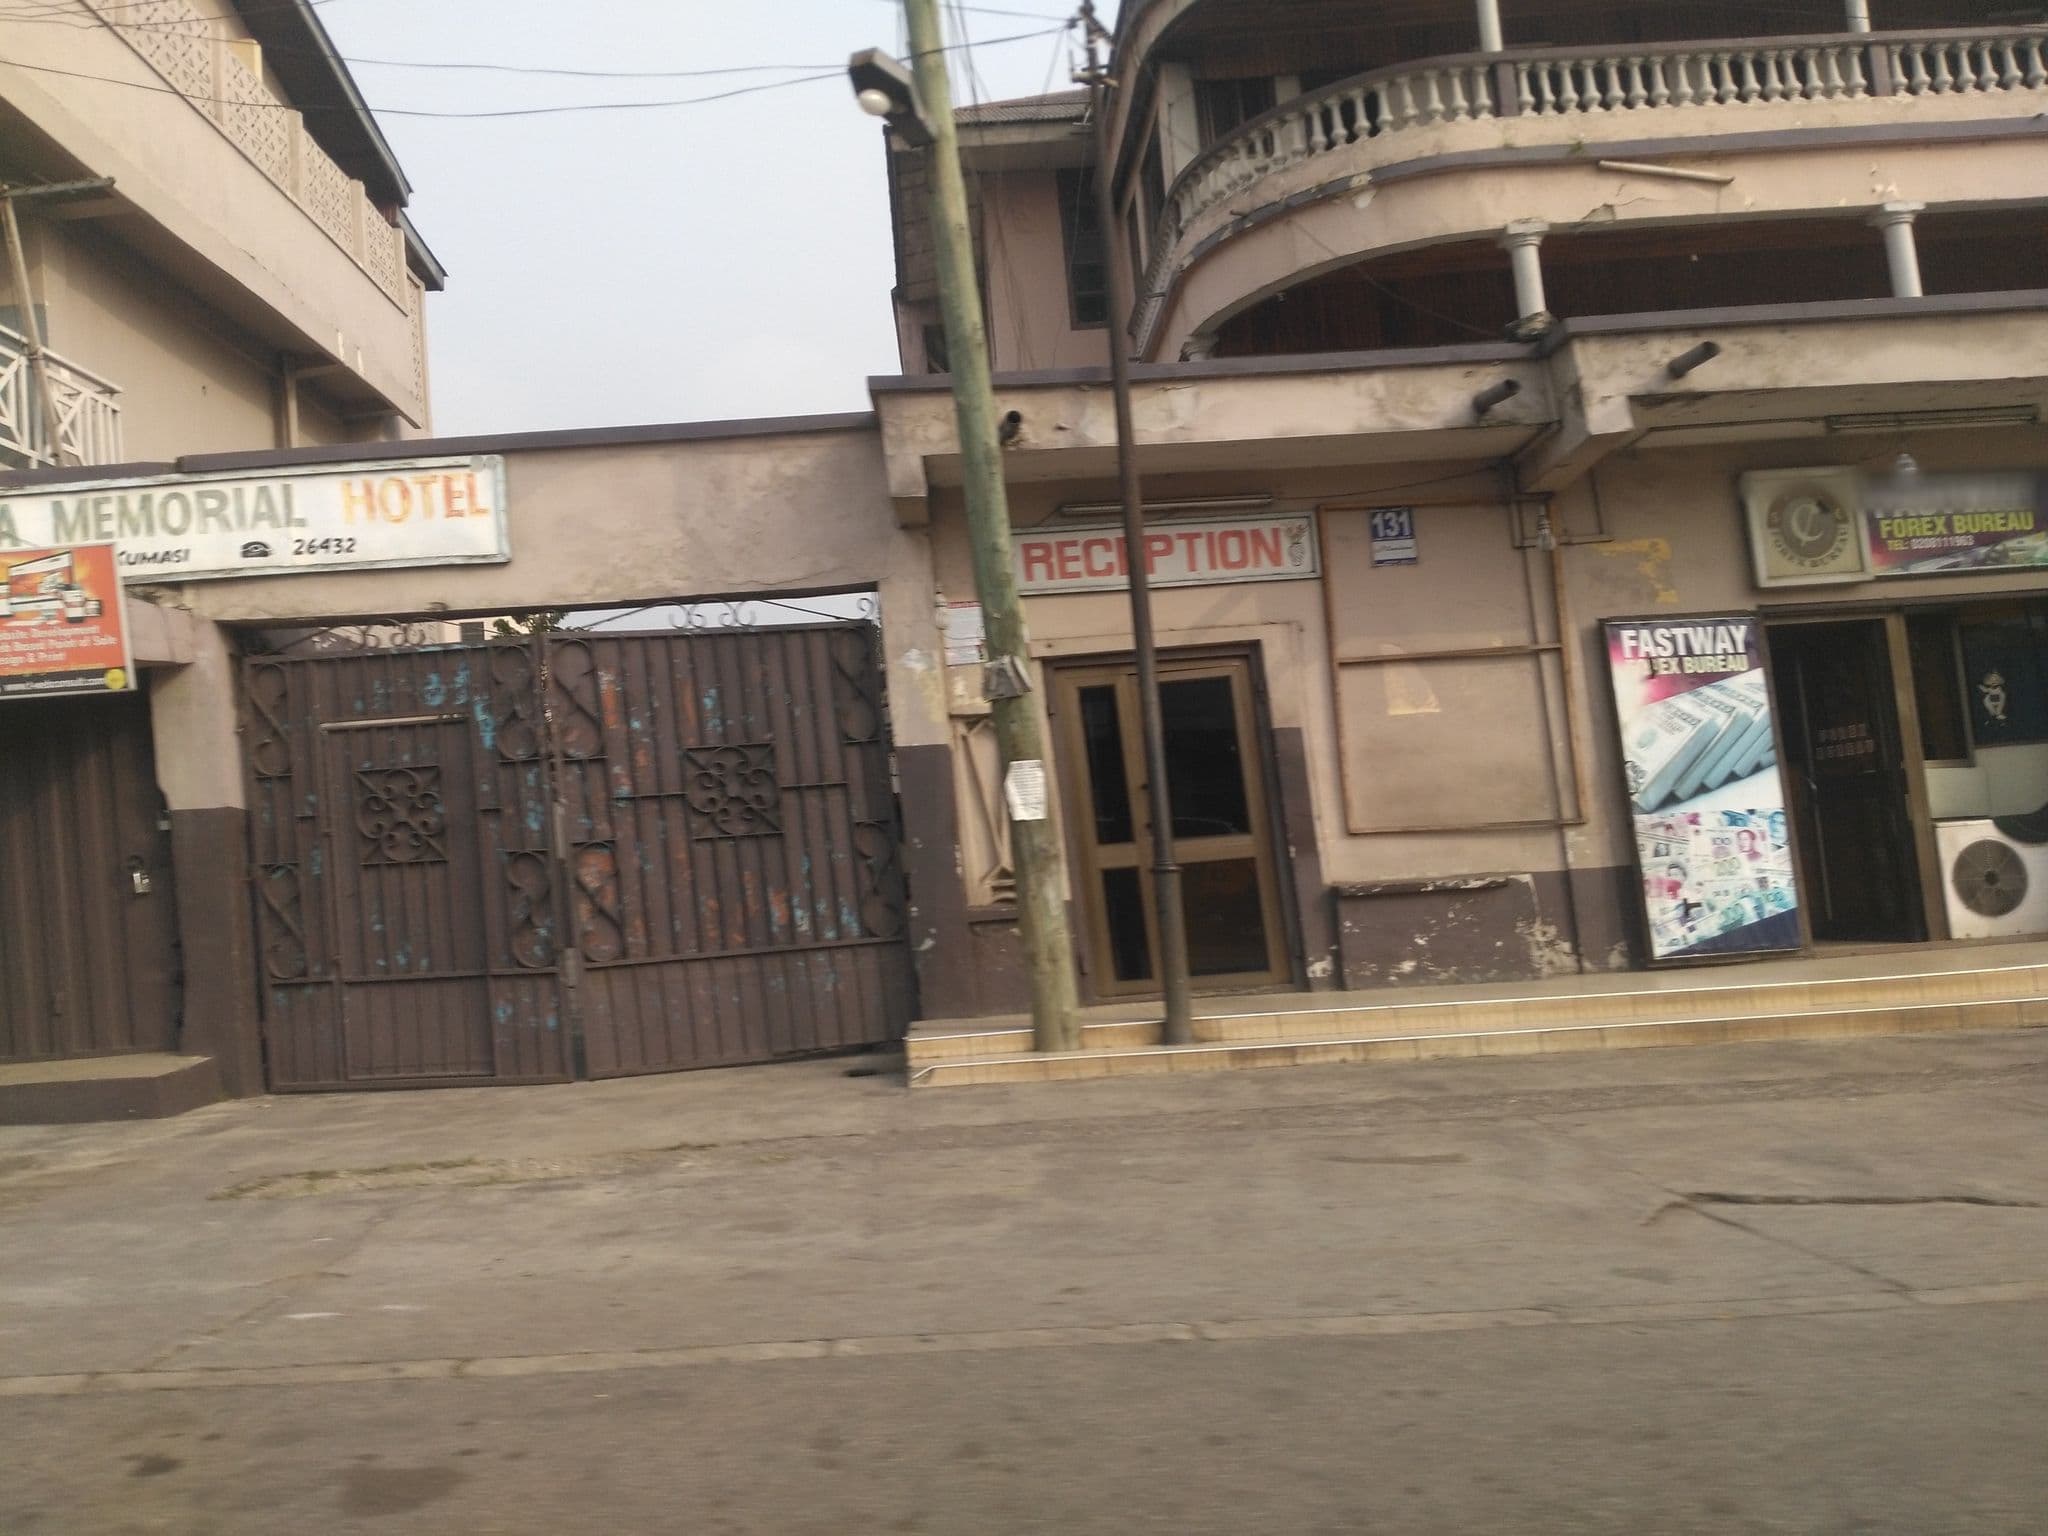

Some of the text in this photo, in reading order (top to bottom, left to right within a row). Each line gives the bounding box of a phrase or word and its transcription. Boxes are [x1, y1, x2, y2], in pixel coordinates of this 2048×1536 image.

[52, 484, 307, 543] MEMORIAL
[343, 472, 488, 522] HOTEL
[1371, 511, 1411, 537] 131
[1880, 511, 2034, 539] FOREX BUREAU
[293, 537, 357, 556] 26432
[1620, 625, 1748, 658] FASTWAY
[1684, 654, 1749, 673] BUREAU
